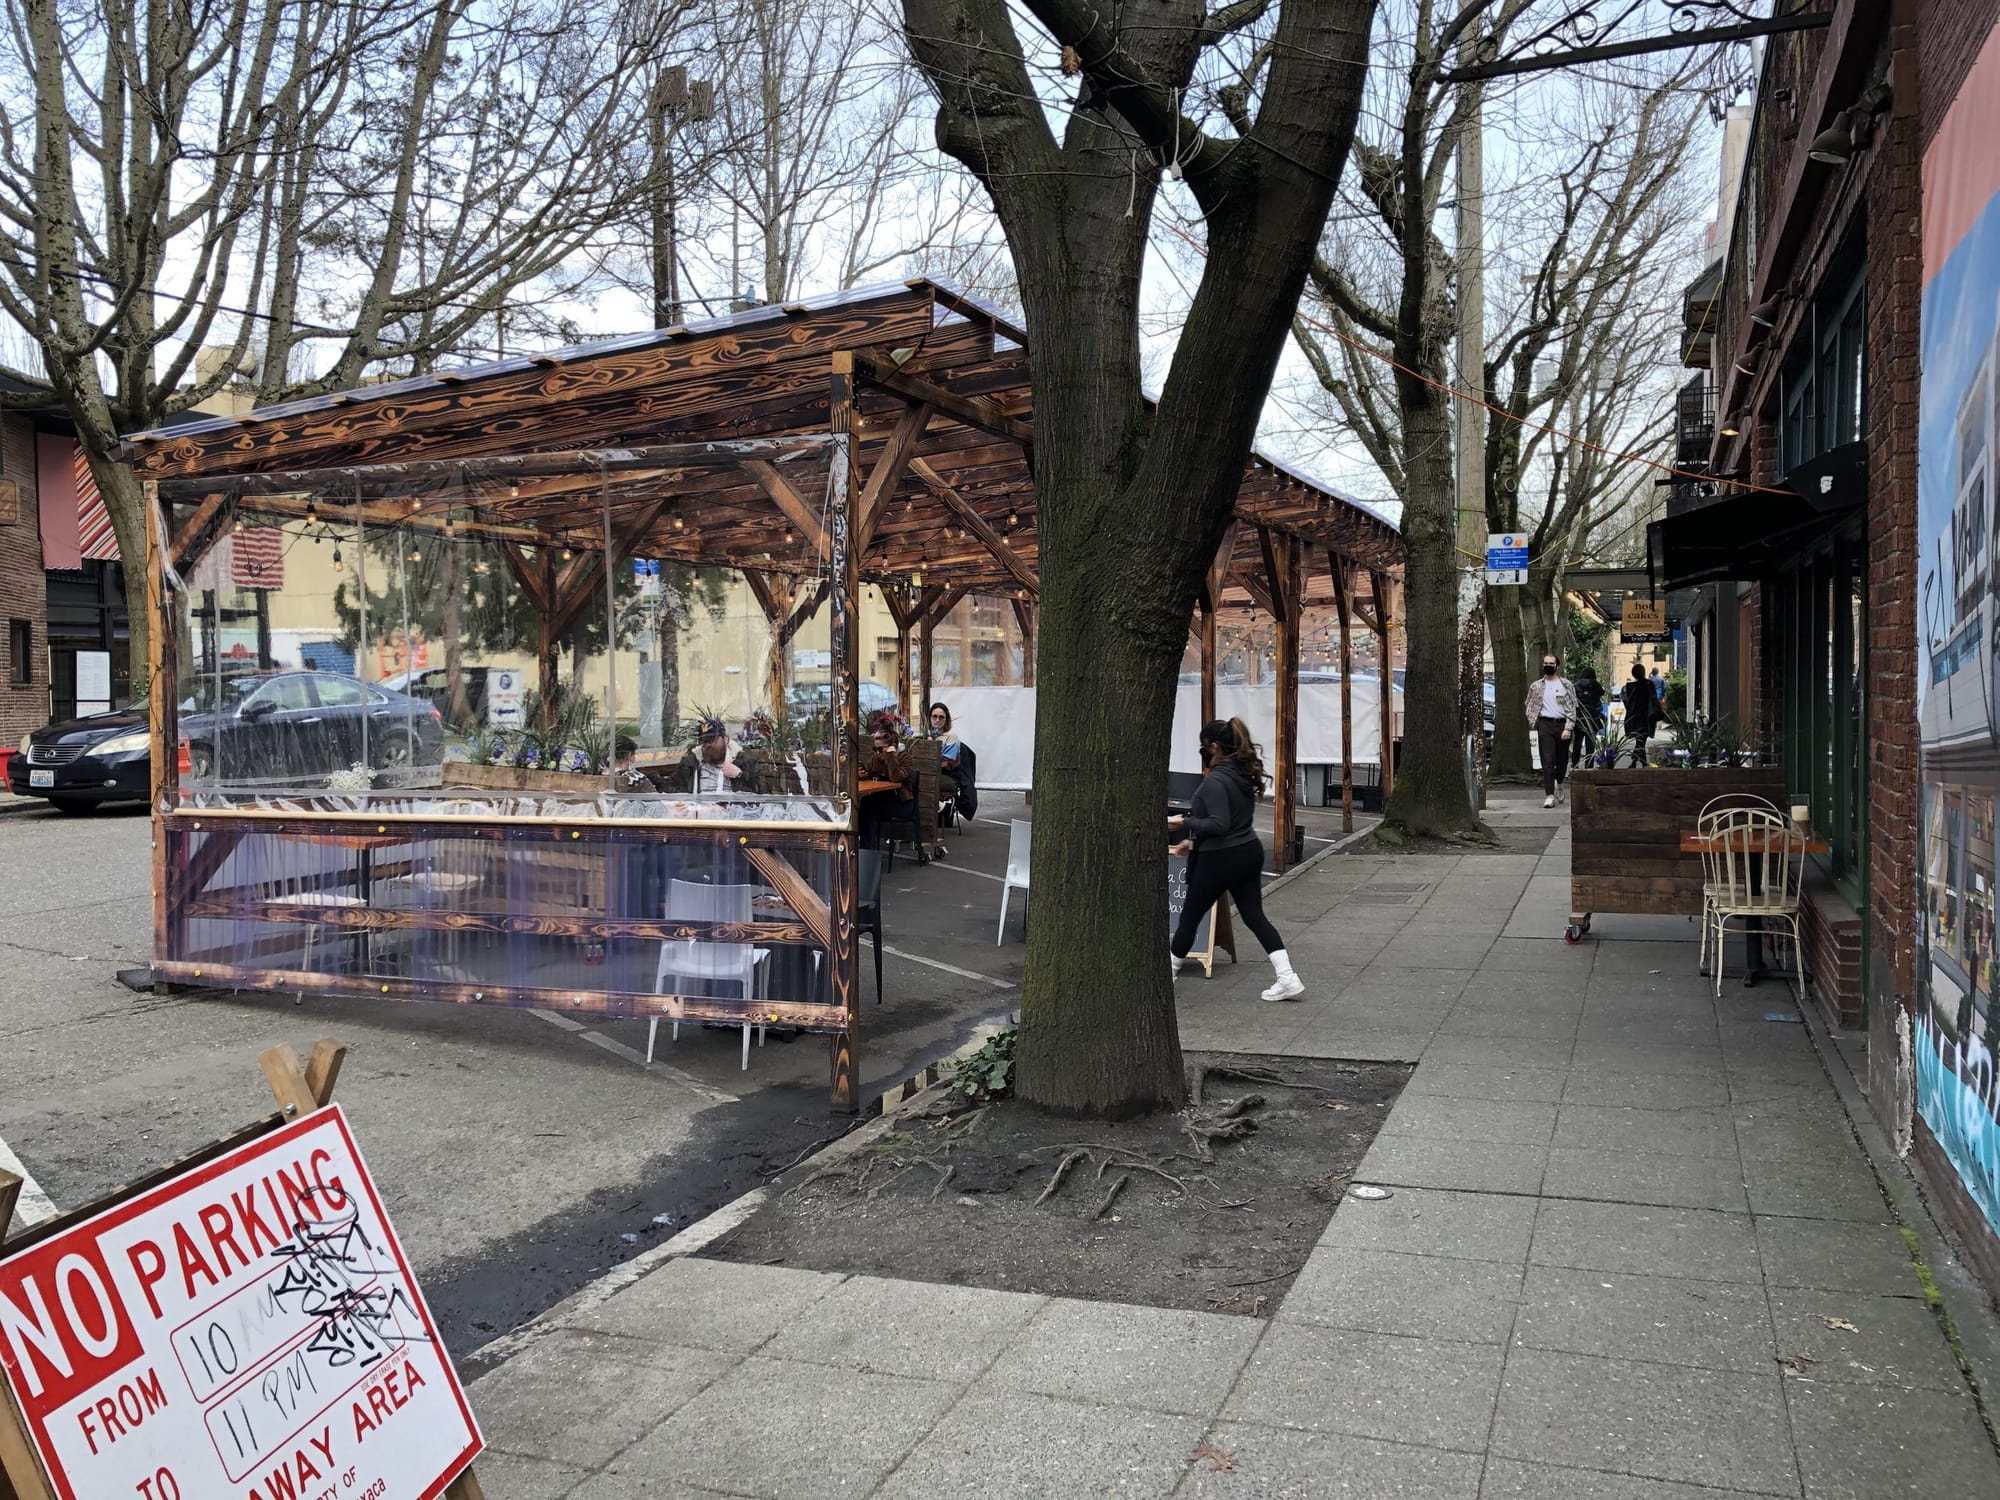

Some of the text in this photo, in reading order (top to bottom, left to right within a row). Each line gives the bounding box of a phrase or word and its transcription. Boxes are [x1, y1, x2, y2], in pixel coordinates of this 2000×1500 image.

[1628, 611, 1659, 620] cakes
[1173, 883, 1187, 899] de
[0, 1253, 119, 1398] NO
[127, 1149, 347, 1319] PARKING
[189, 1322, 238, 1384] 10
[77, 1368, 168, 1456] FROM
[222, 1350, 317, 1458] 11 PM
[352, 1359, 427, 1444] AREA
[342, 1466, 356, 1488] OF
